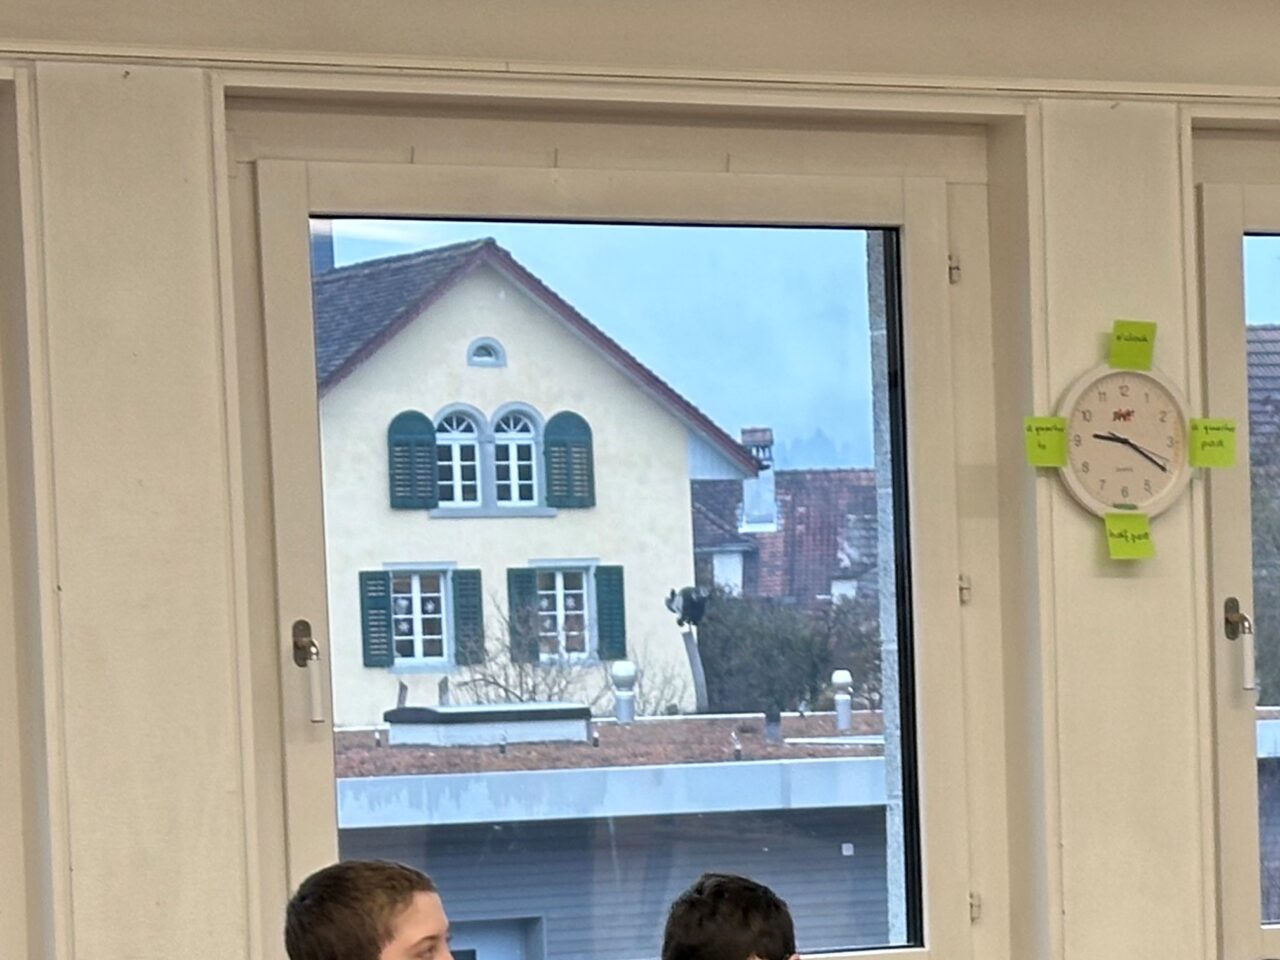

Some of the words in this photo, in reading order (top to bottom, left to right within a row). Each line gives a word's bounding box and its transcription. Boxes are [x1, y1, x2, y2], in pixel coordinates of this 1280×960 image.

[1098, 391, 1107, 402] 11
[1118, 384, 1130, 397] 12
[1081, 409, 1092, 422] 10
[1159, 410, 1167, 423] 2
[1074, 434, 1082, 447] 9
[1167, 436, 1174, 448] 3
[1081, 461, 1089, 474] 8
[1099, 479, 1106, 491] 7
[1121, 486, 1129, 498] 6
